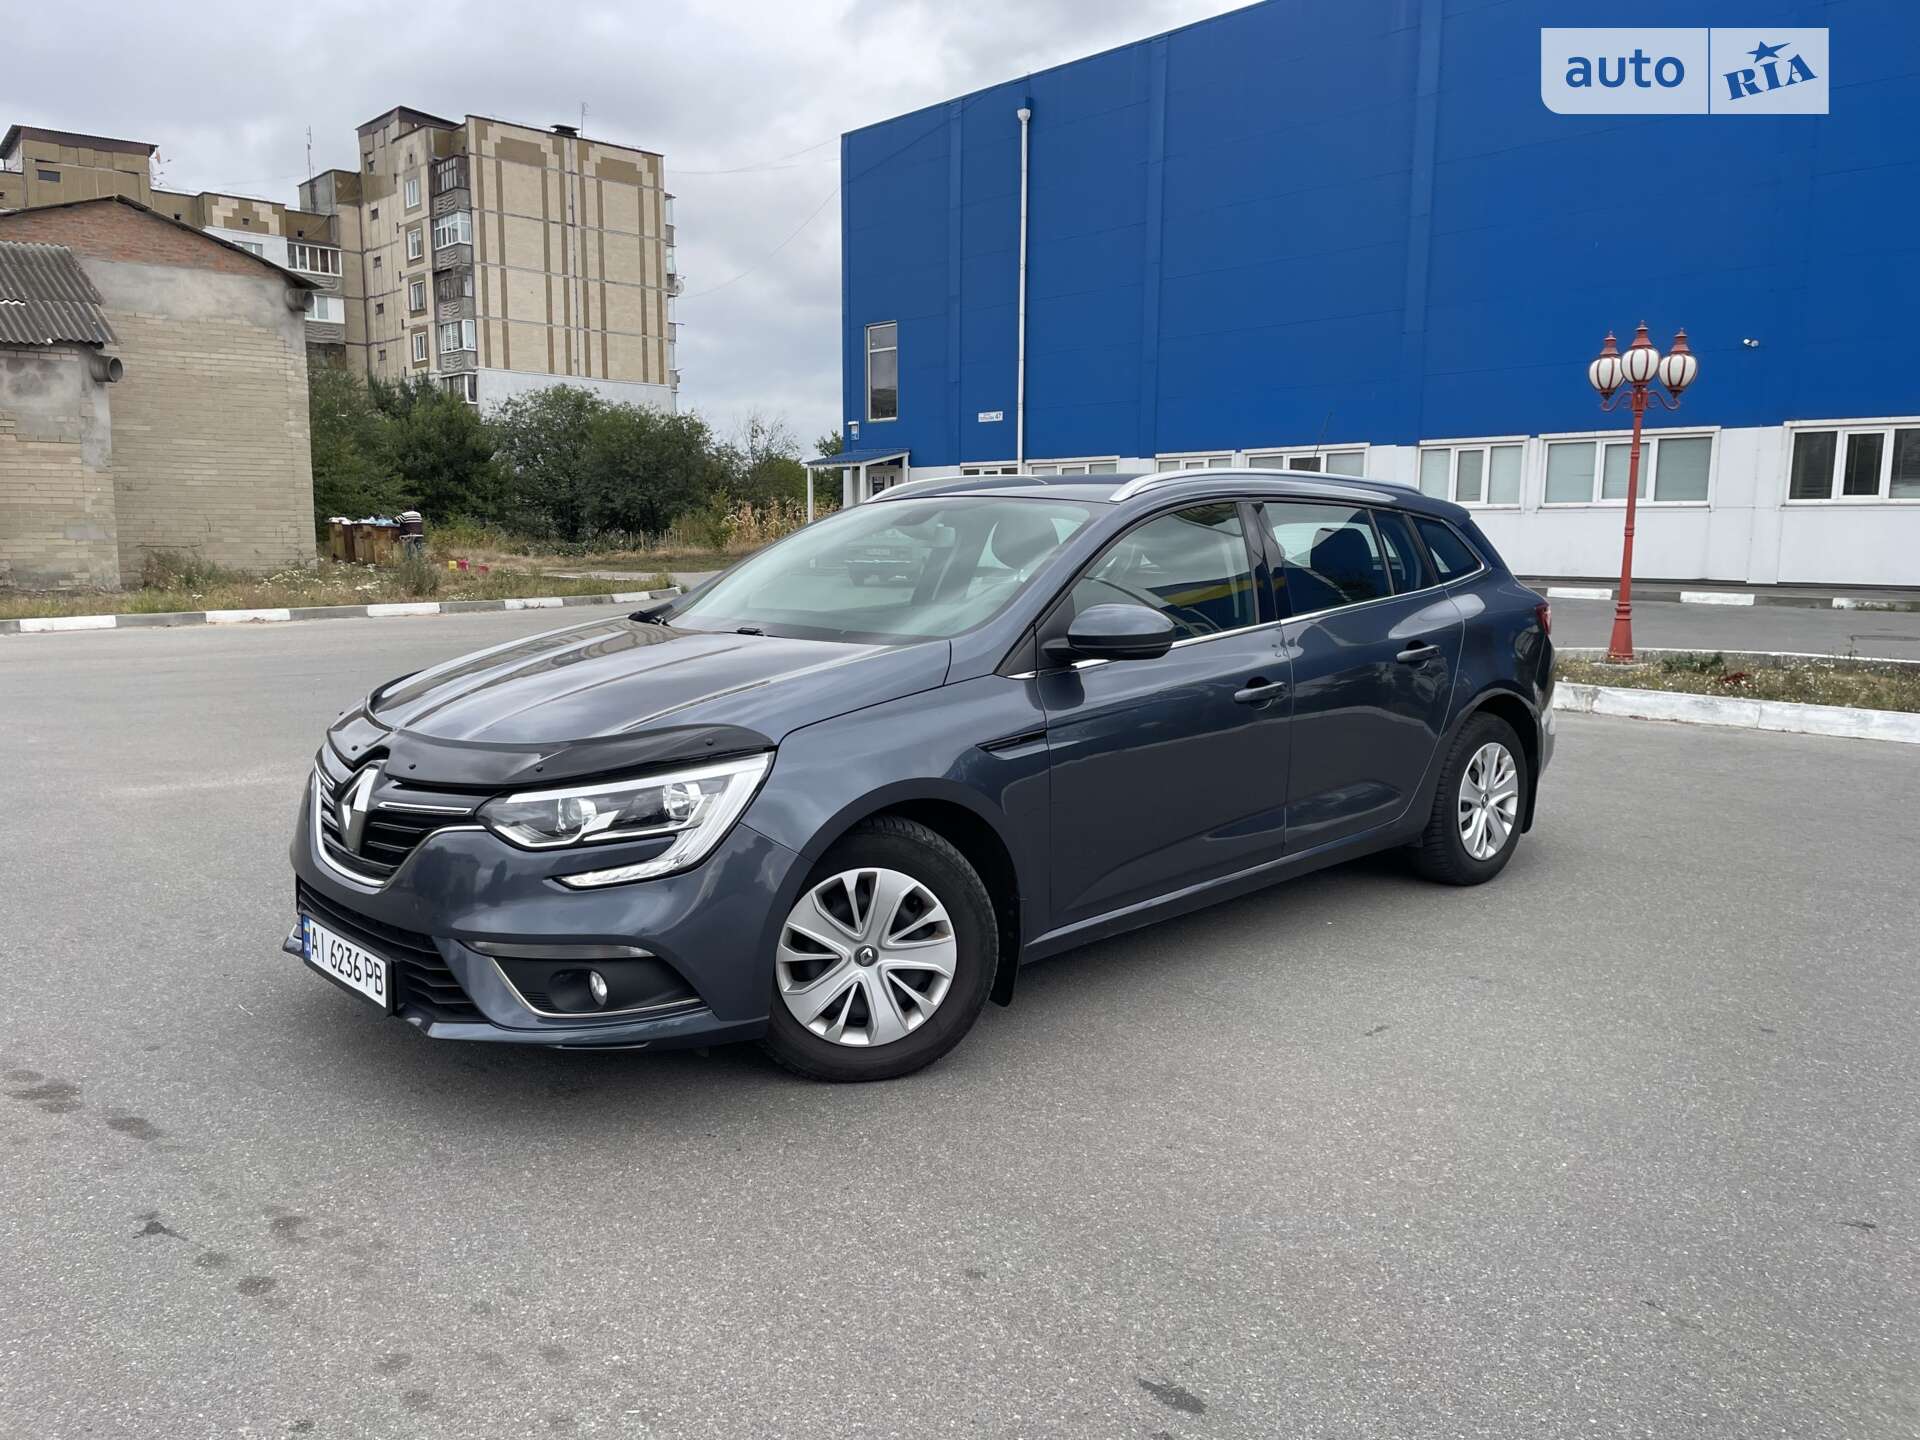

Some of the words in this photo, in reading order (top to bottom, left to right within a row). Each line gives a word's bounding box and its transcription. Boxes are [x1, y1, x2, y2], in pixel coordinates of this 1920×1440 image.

[312, 927, 325, 963] AI
[330, 939, 362, 983] 6236
[364, 955, 384, 997] PB
